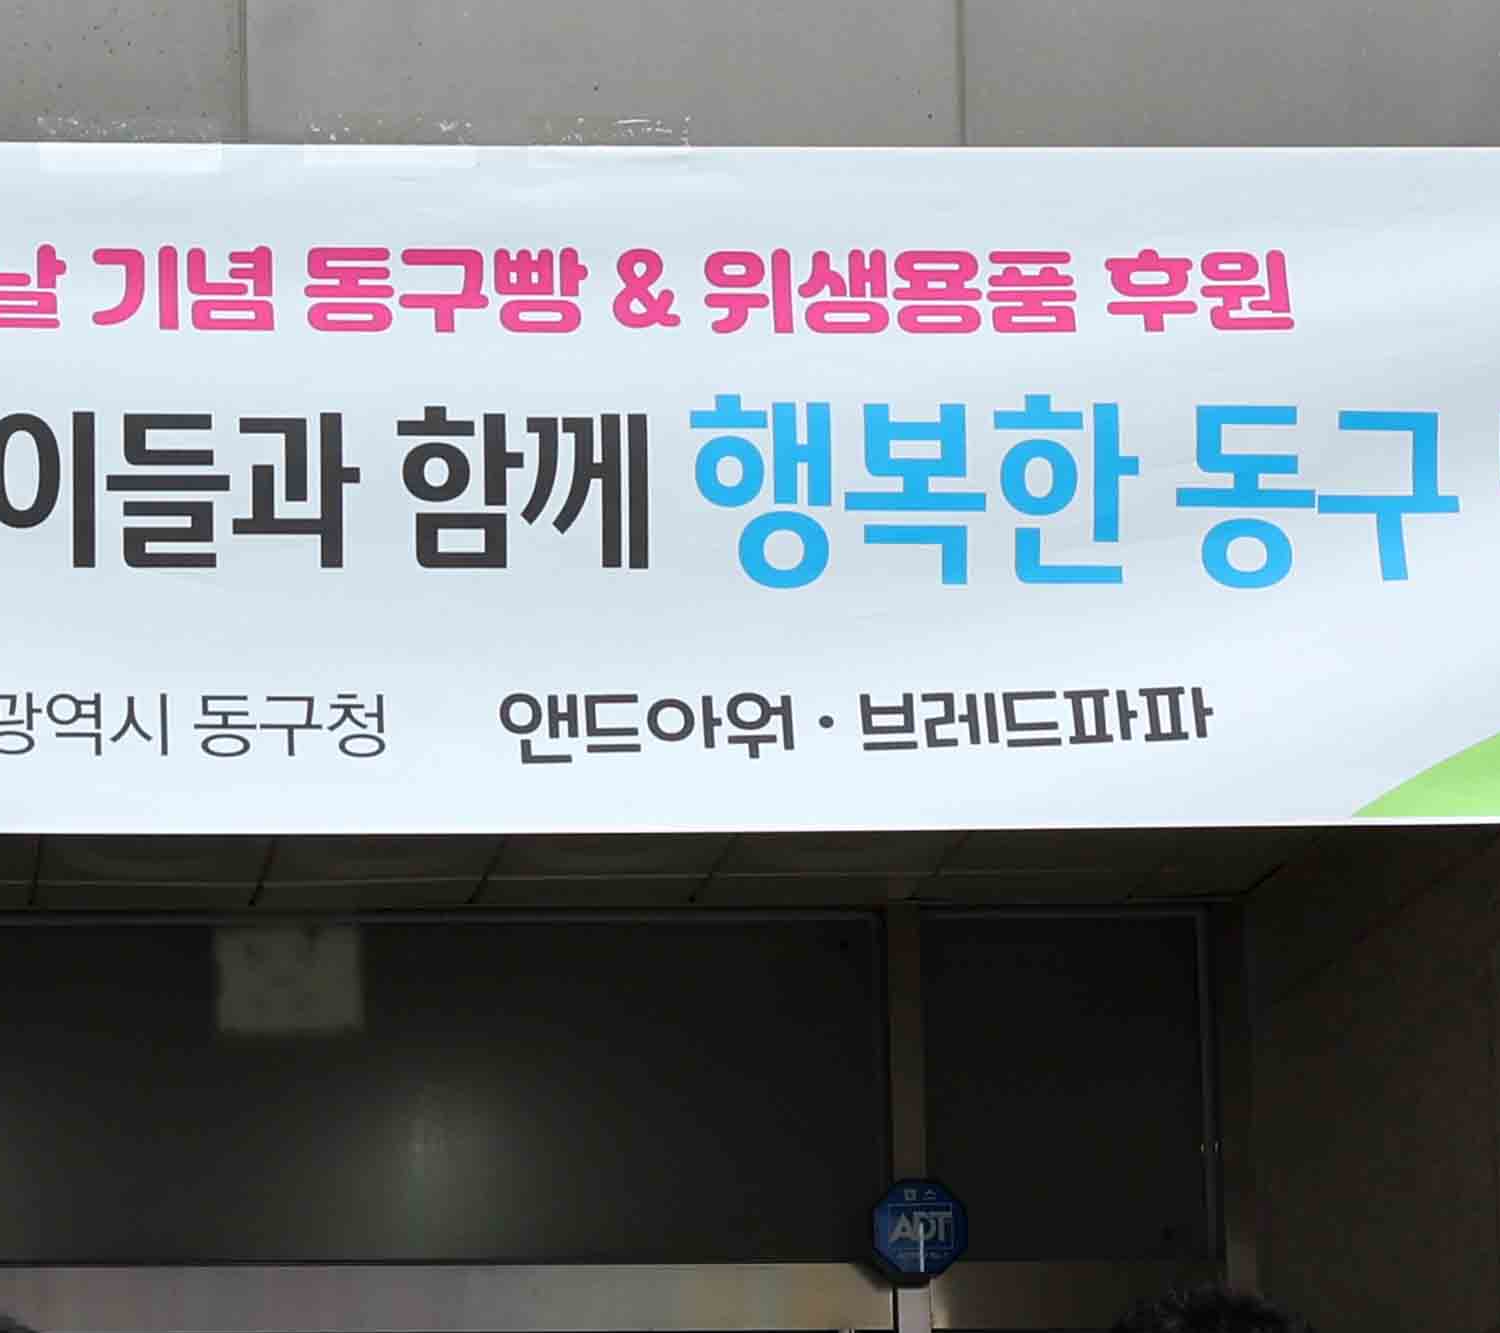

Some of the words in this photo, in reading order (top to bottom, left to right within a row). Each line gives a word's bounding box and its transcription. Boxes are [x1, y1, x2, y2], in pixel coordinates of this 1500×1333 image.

[93, 246, 274, 331] 기념
[304, 247, 588, 333] 동구빵
[613, 249, 680, 328] &
[704, 248, 1076, 333] 위생용품
[1104, 249, 1294, 332] 후원
[397, 406, 648, 569] 함께
[690, 395, 1139, 588] 행복한
[1176, 406, 1459, 588] 동구
[194, 694, 385, 757] 동구청
[500, 693, 794, 764] 앤드아워
[860, 687, 1213, 751] 브레드파파
[889, 1211, 953, 1243] ADT
